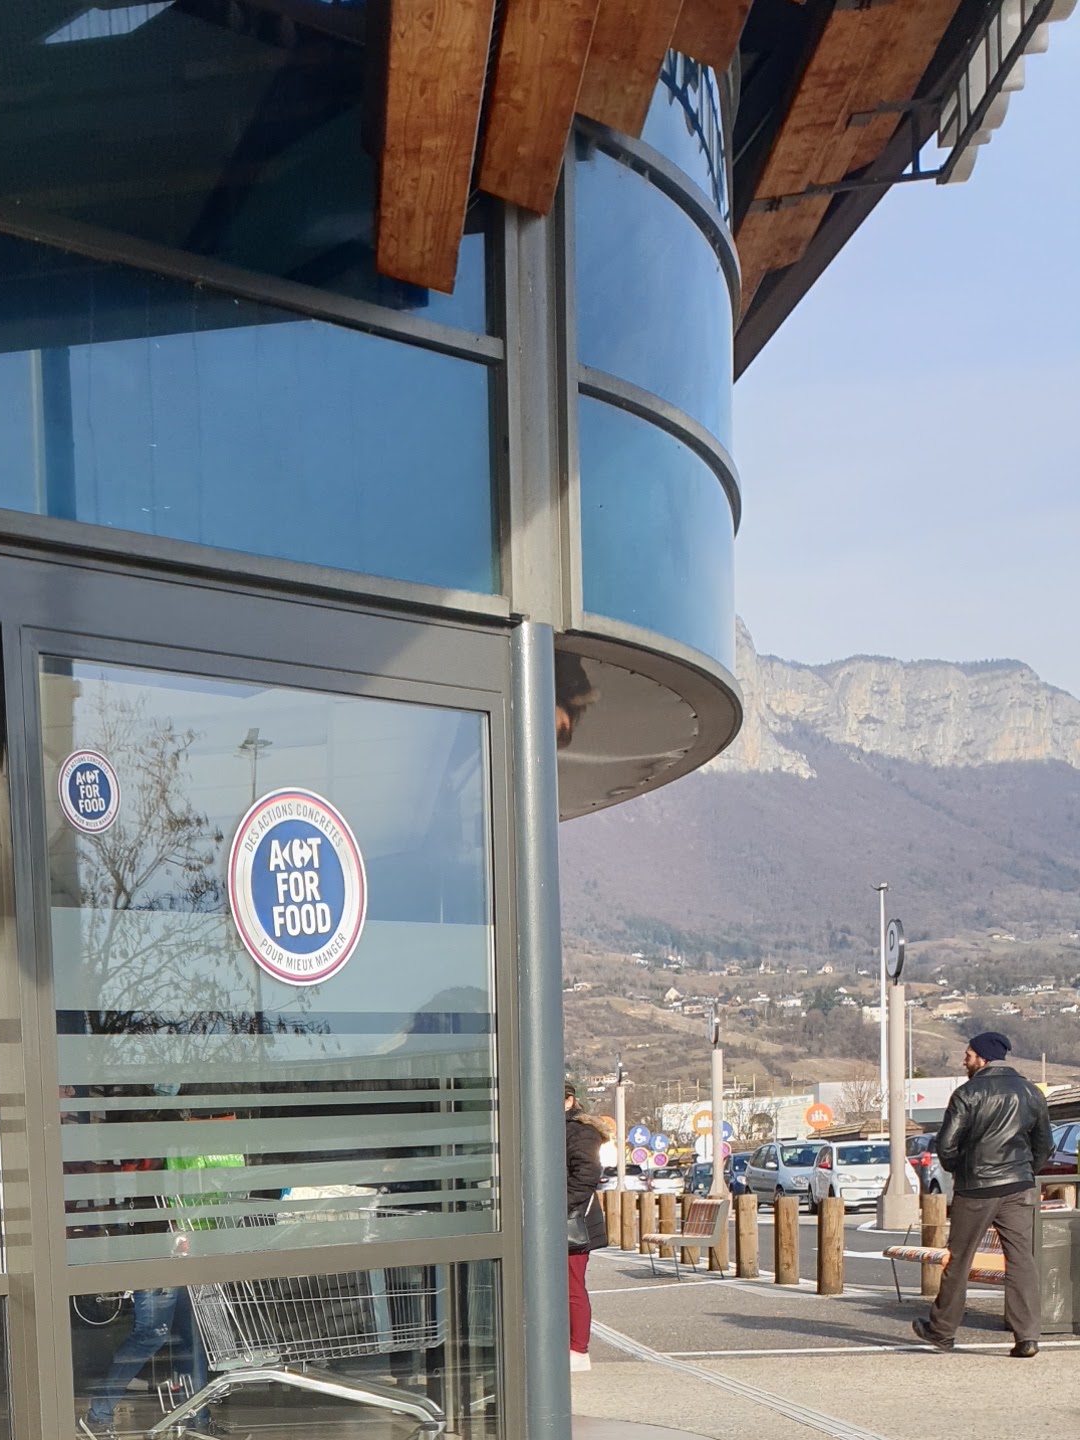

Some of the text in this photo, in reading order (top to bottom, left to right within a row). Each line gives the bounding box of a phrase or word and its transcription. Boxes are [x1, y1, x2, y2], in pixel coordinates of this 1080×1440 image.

[78, 797, 106, 814] FOOD
[80, 784, 100, 799] FOR
[244, 828, 260, 853] DES
[258, 803, 293, 833] ACTIONS
[276, 870, 321, 904] FOR
[272, 902, 331, 938] FOOD
[259, 932, 347, 971] POUR MIEUX MANGER
